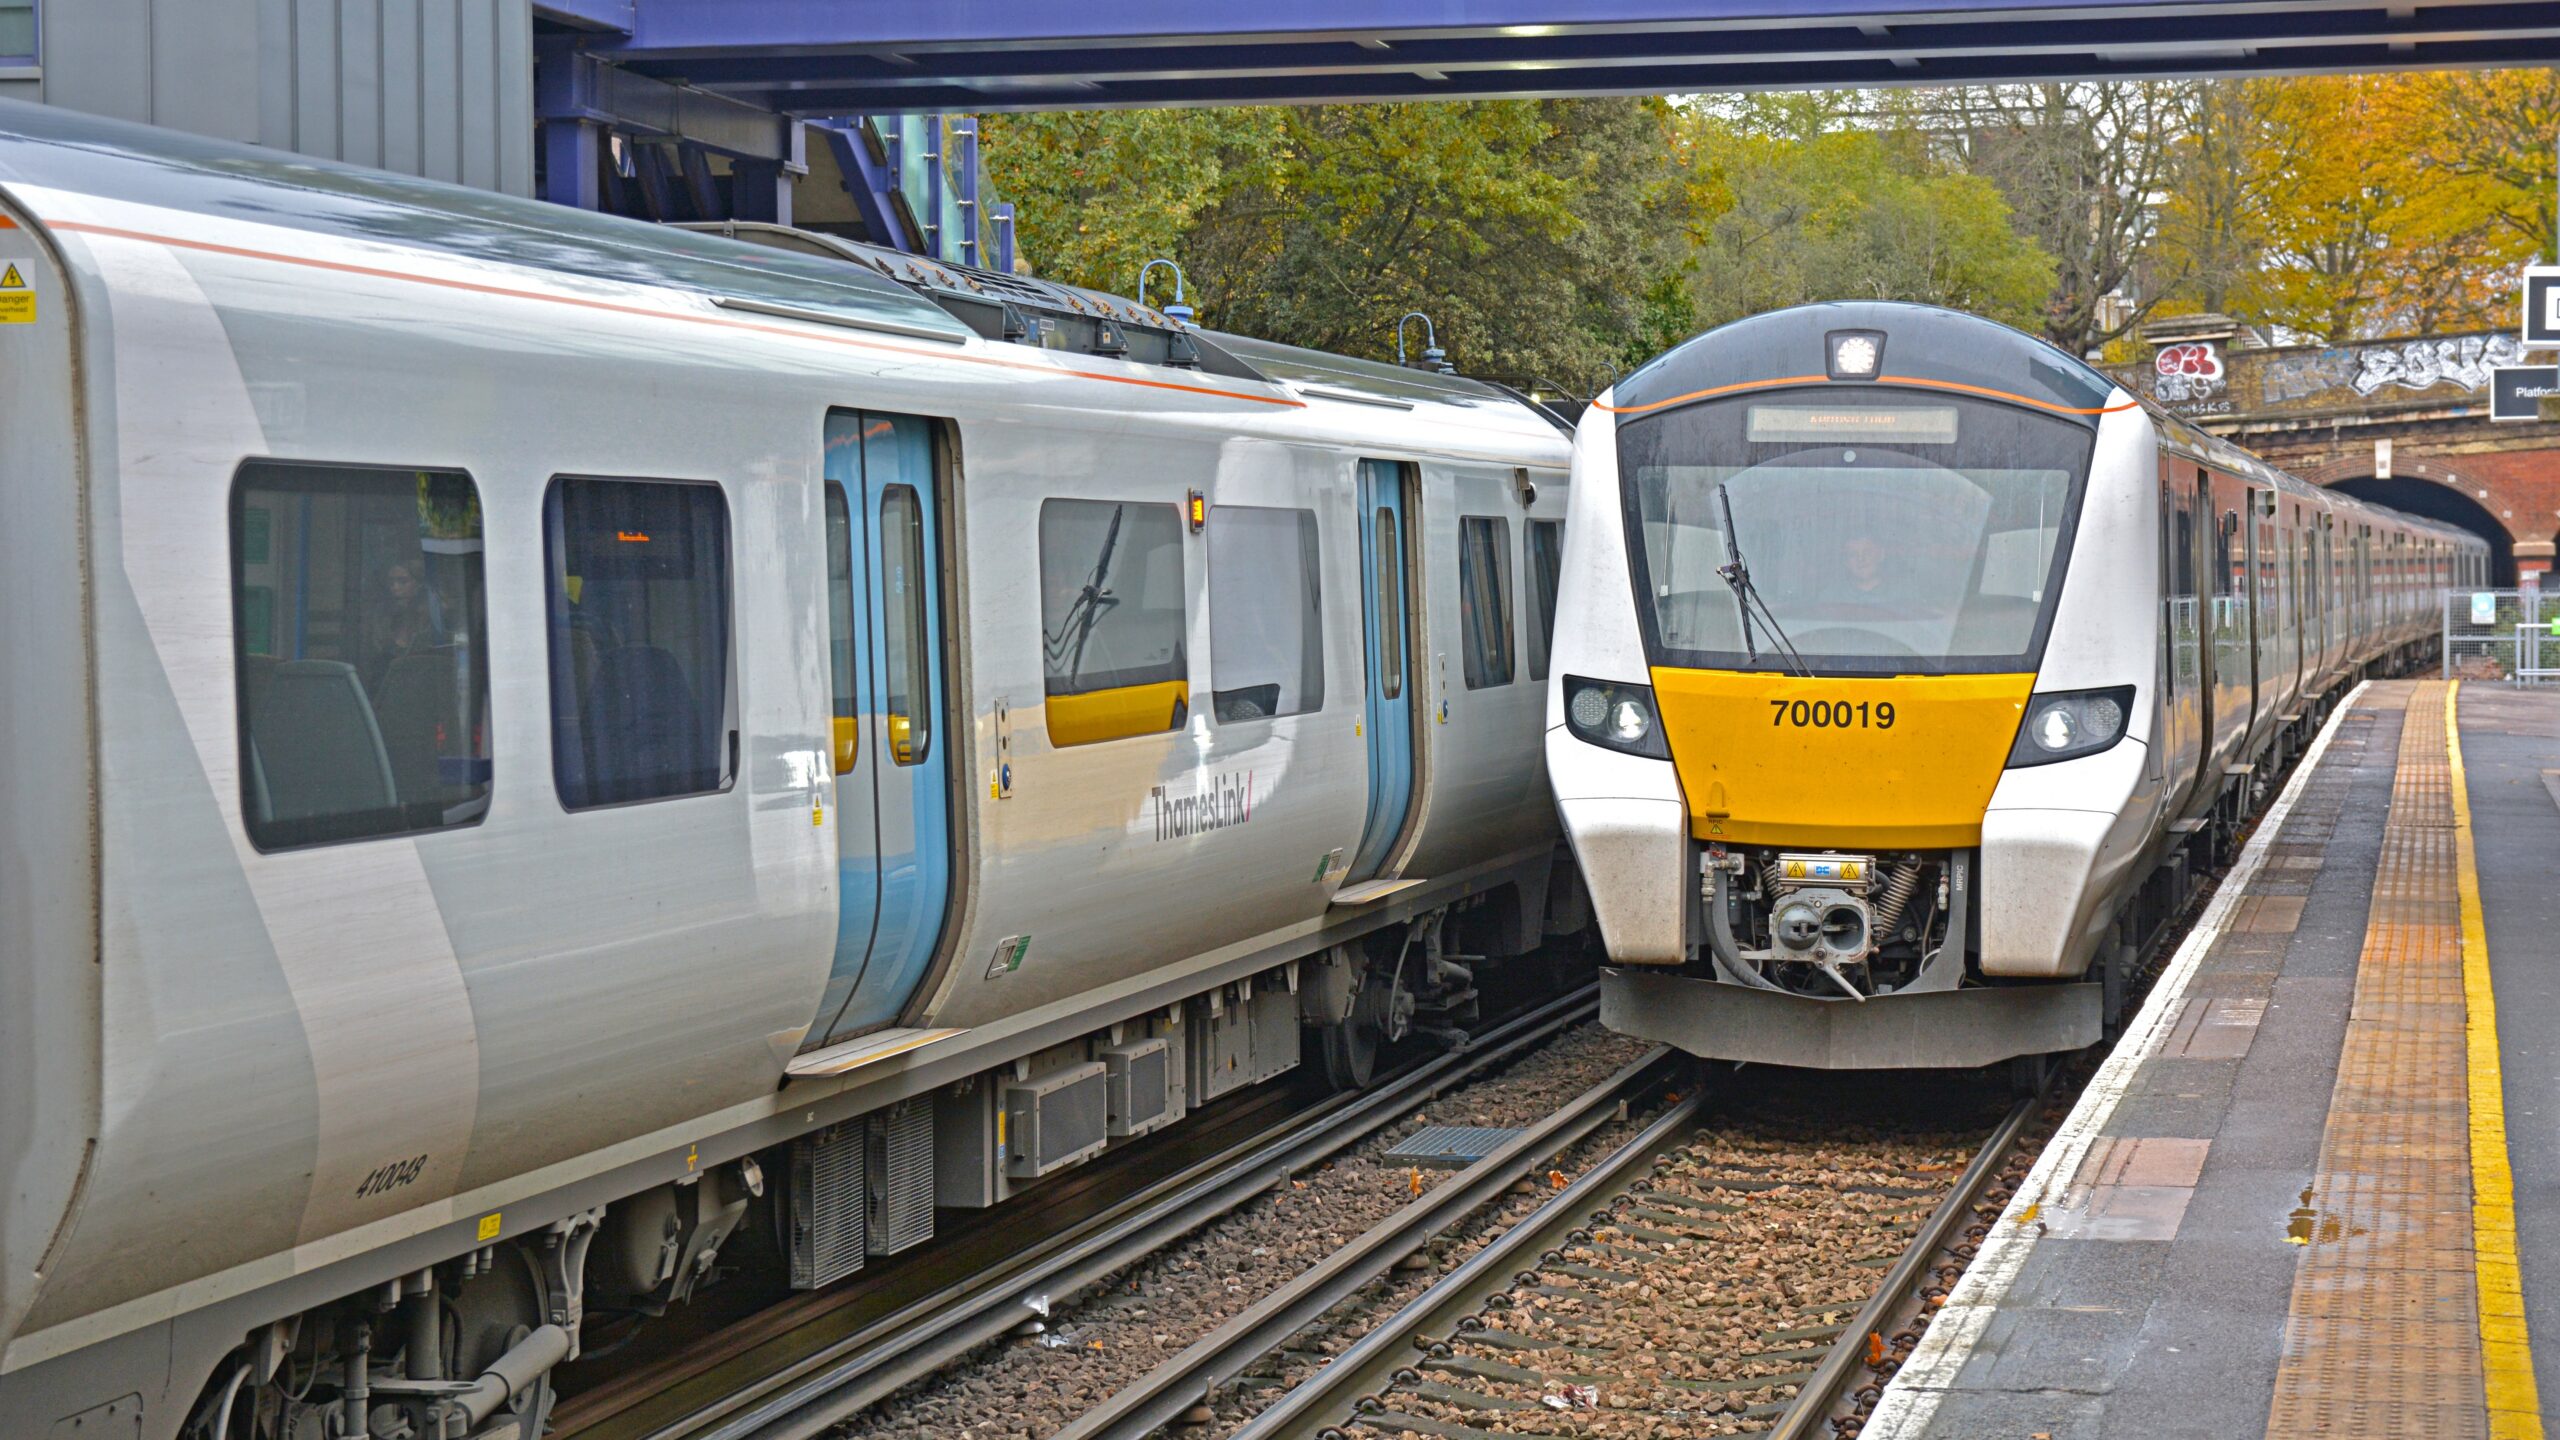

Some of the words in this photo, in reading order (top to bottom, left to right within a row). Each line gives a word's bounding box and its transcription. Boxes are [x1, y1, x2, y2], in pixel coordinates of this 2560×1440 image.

[0, 295, 30, 305] anger
[2515, 386, 2558, 398] Platfo
[1770, 700, 1895, 729] 700019
[356, 1154, 428, 1199] 410048
